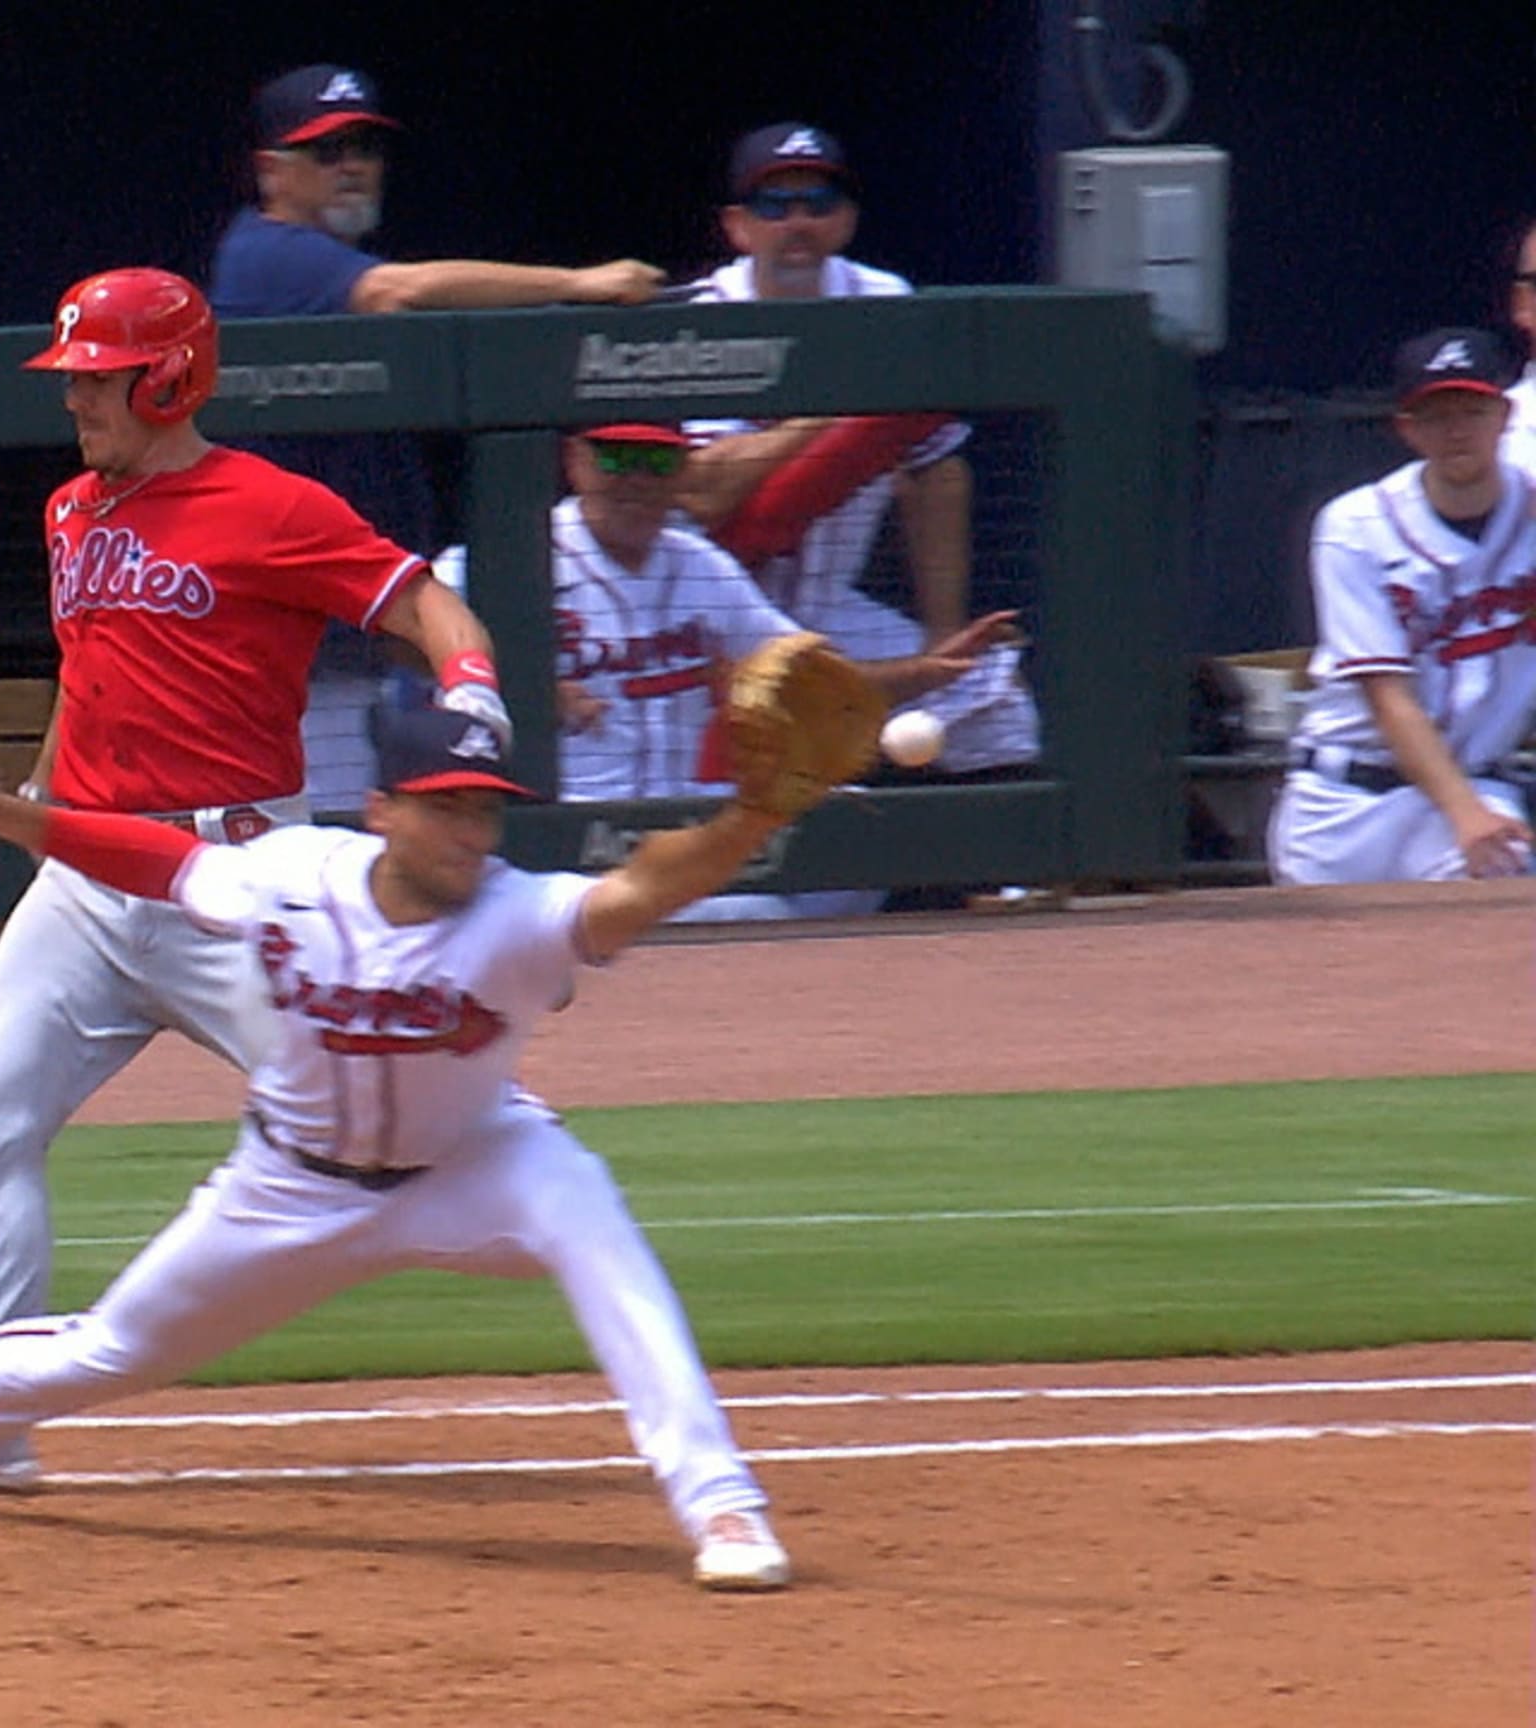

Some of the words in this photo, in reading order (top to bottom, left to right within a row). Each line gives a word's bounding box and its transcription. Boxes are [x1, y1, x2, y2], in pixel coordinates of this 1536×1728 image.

[317, 73, 364, 101] A
[773, 131, 822, 154] A
[59, 304, 80, 345] P
[567, 330, 797, 382] Academy
[1424, 340, 1473, 371] A
[448, 724, 499, 760] A
